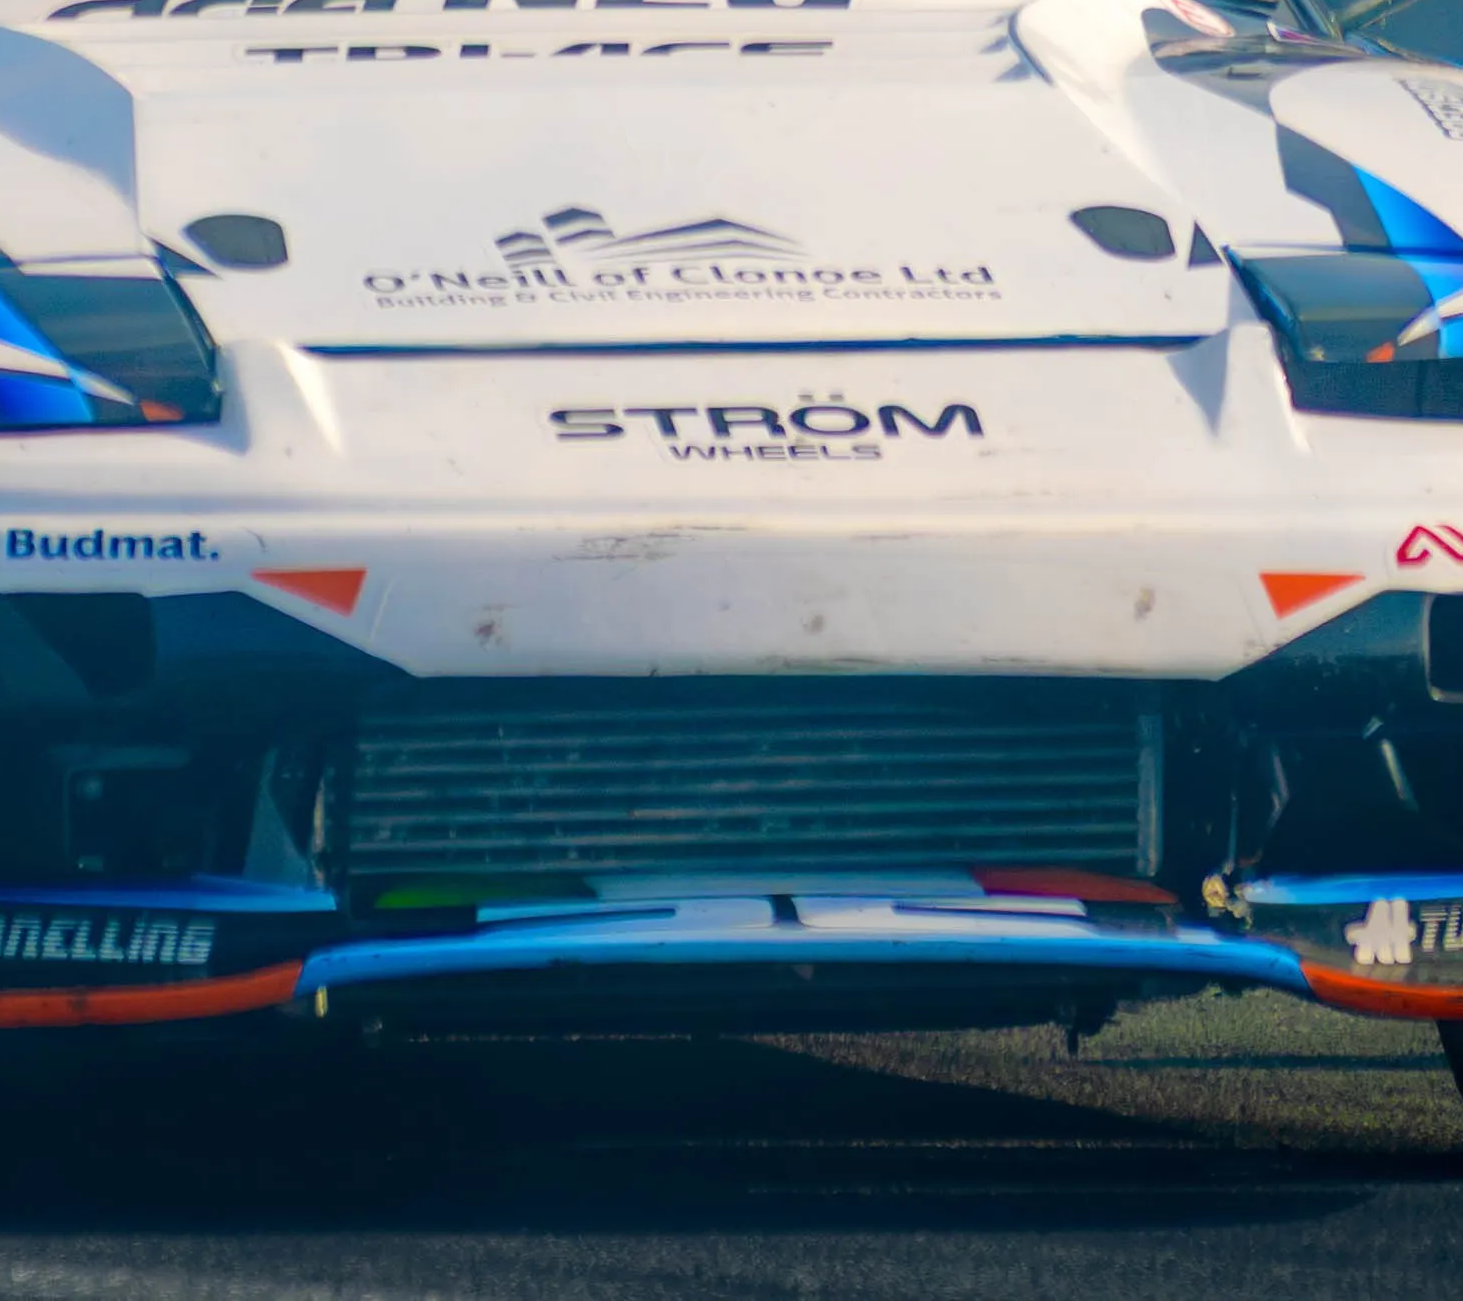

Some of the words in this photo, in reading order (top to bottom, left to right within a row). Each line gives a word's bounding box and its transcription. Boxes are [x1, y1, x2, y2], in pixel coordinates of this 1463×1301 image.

[363, 267, 574, 294] O'Neill
[592, 266, 650, 286] of
[671, 265, 882, 285] Clonoe
[900, 265, 995, 285] Ltd
[548, 393, 985, 441] STRÖM
[669, 444, 883, 461] WHEELS
[6, 528, 220, 562] Budmat.
